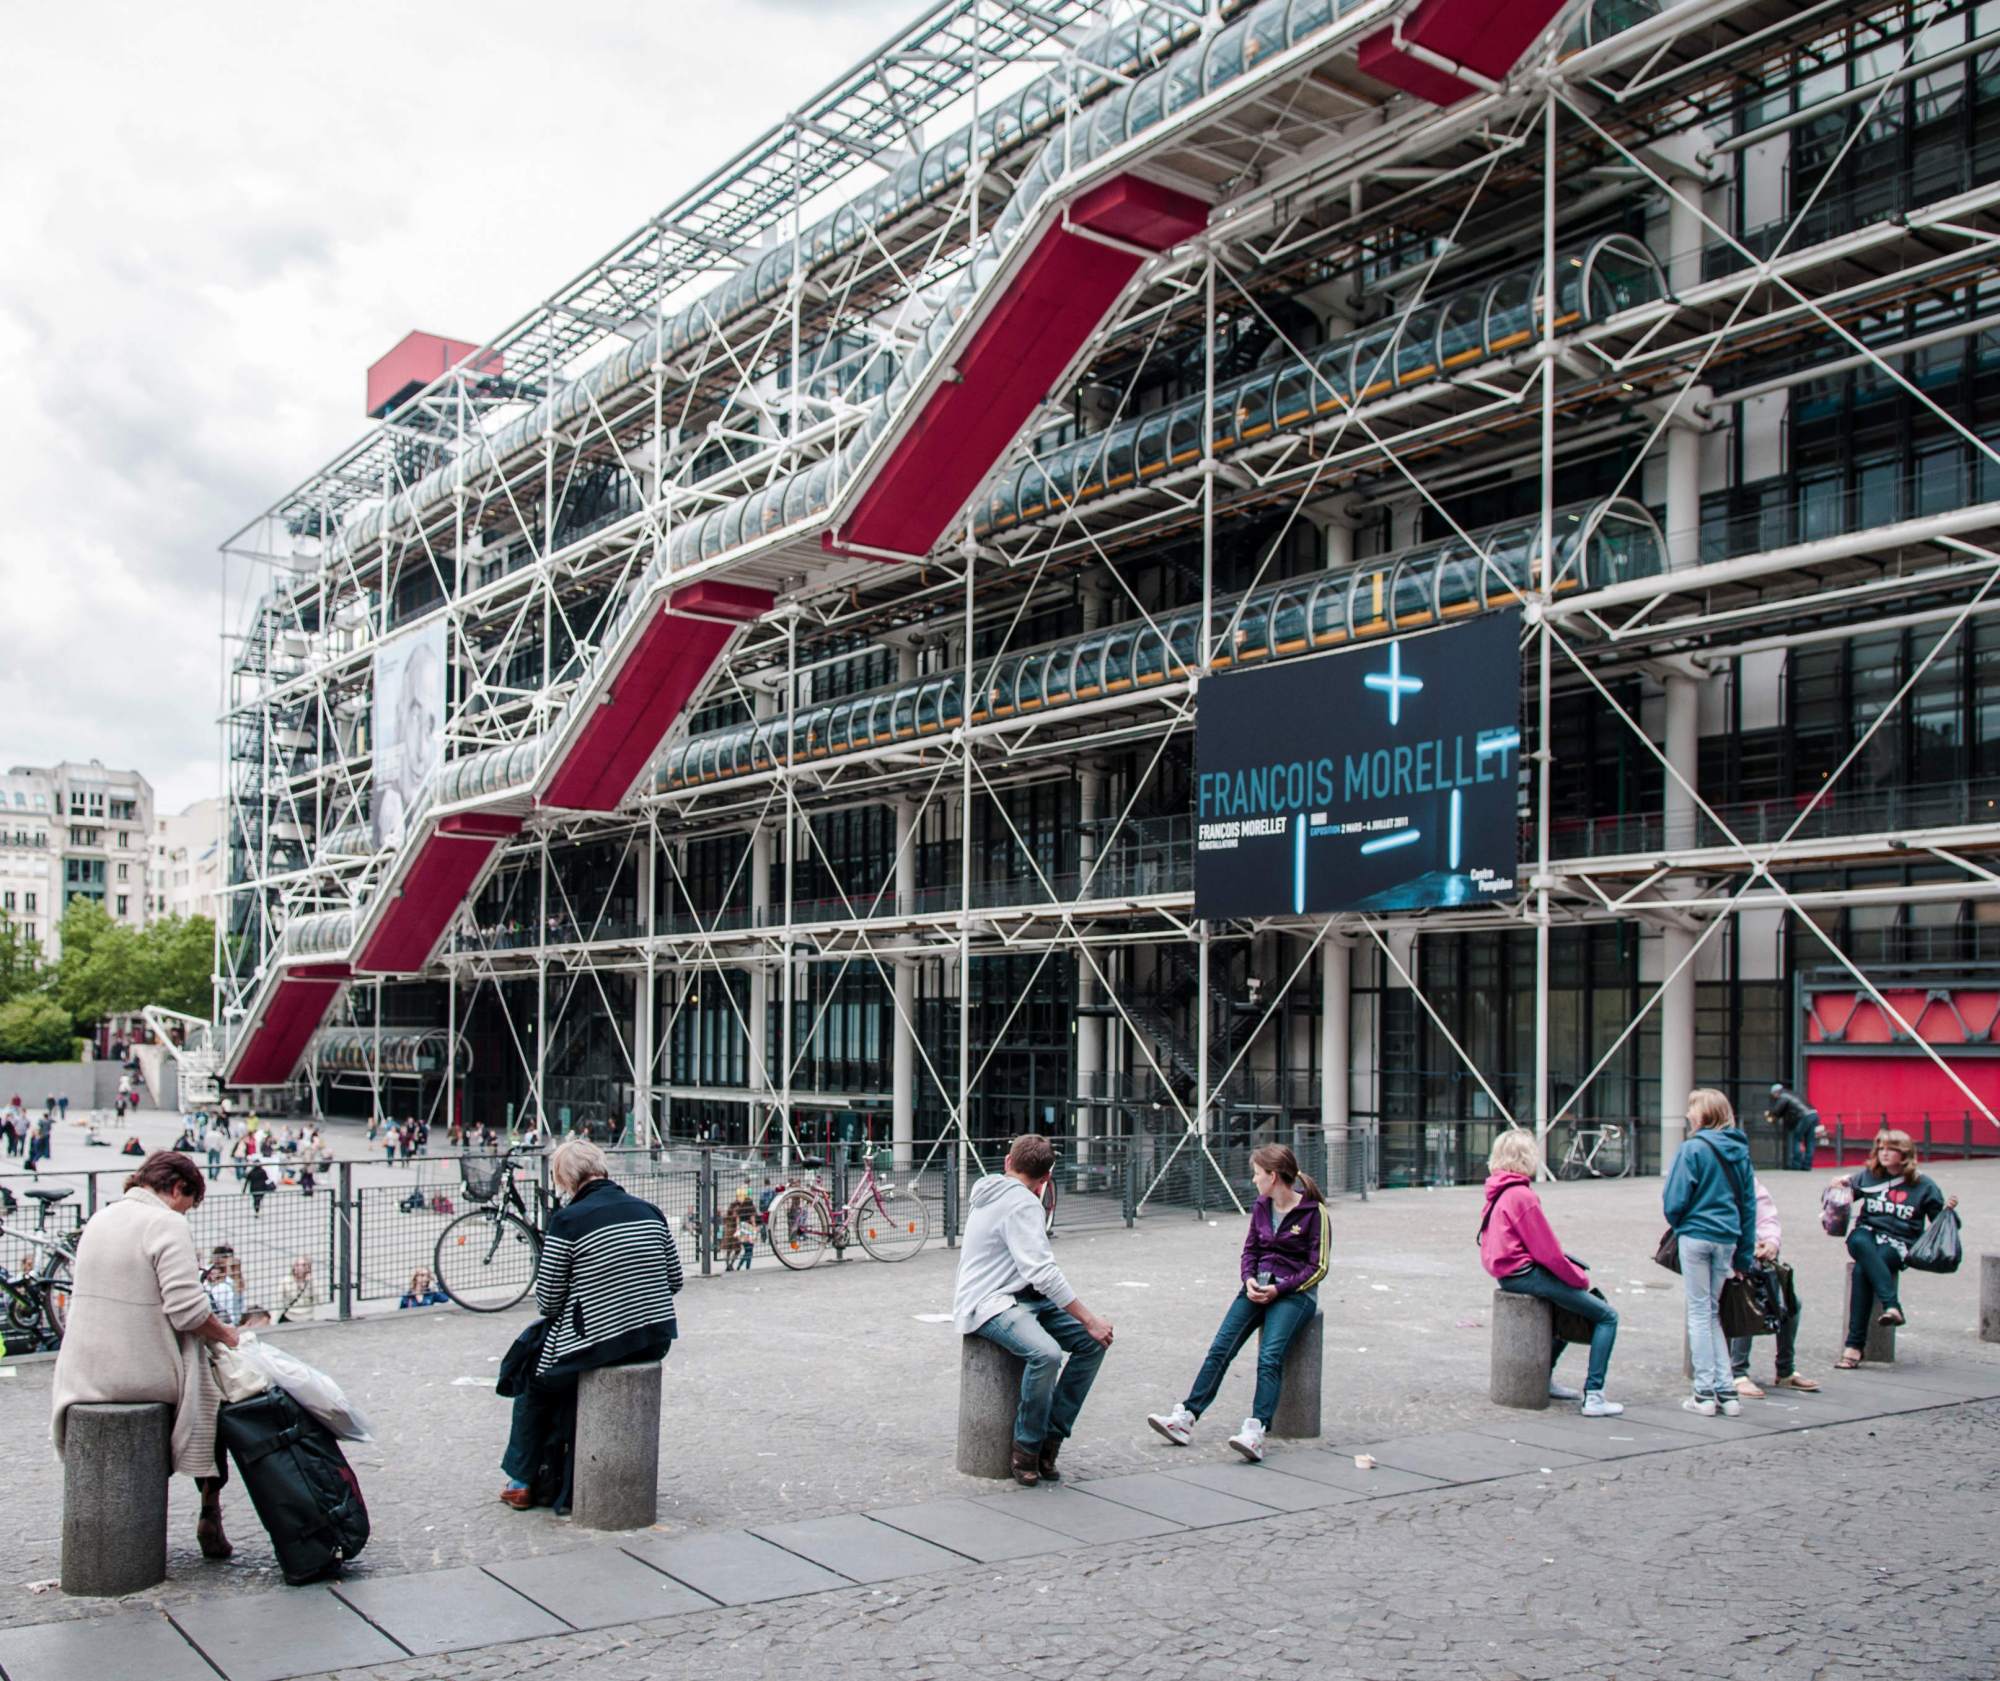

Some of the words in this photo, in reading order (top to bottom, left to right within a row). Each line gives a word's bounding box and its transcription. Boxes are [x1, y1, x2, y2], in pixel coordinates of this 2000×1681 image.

[1199, 757, 1334, 817] FRANÇOIS
[1344, 725, 1516, 803] MORELLET
[1241, 816, 1287, 837] MORELLET
